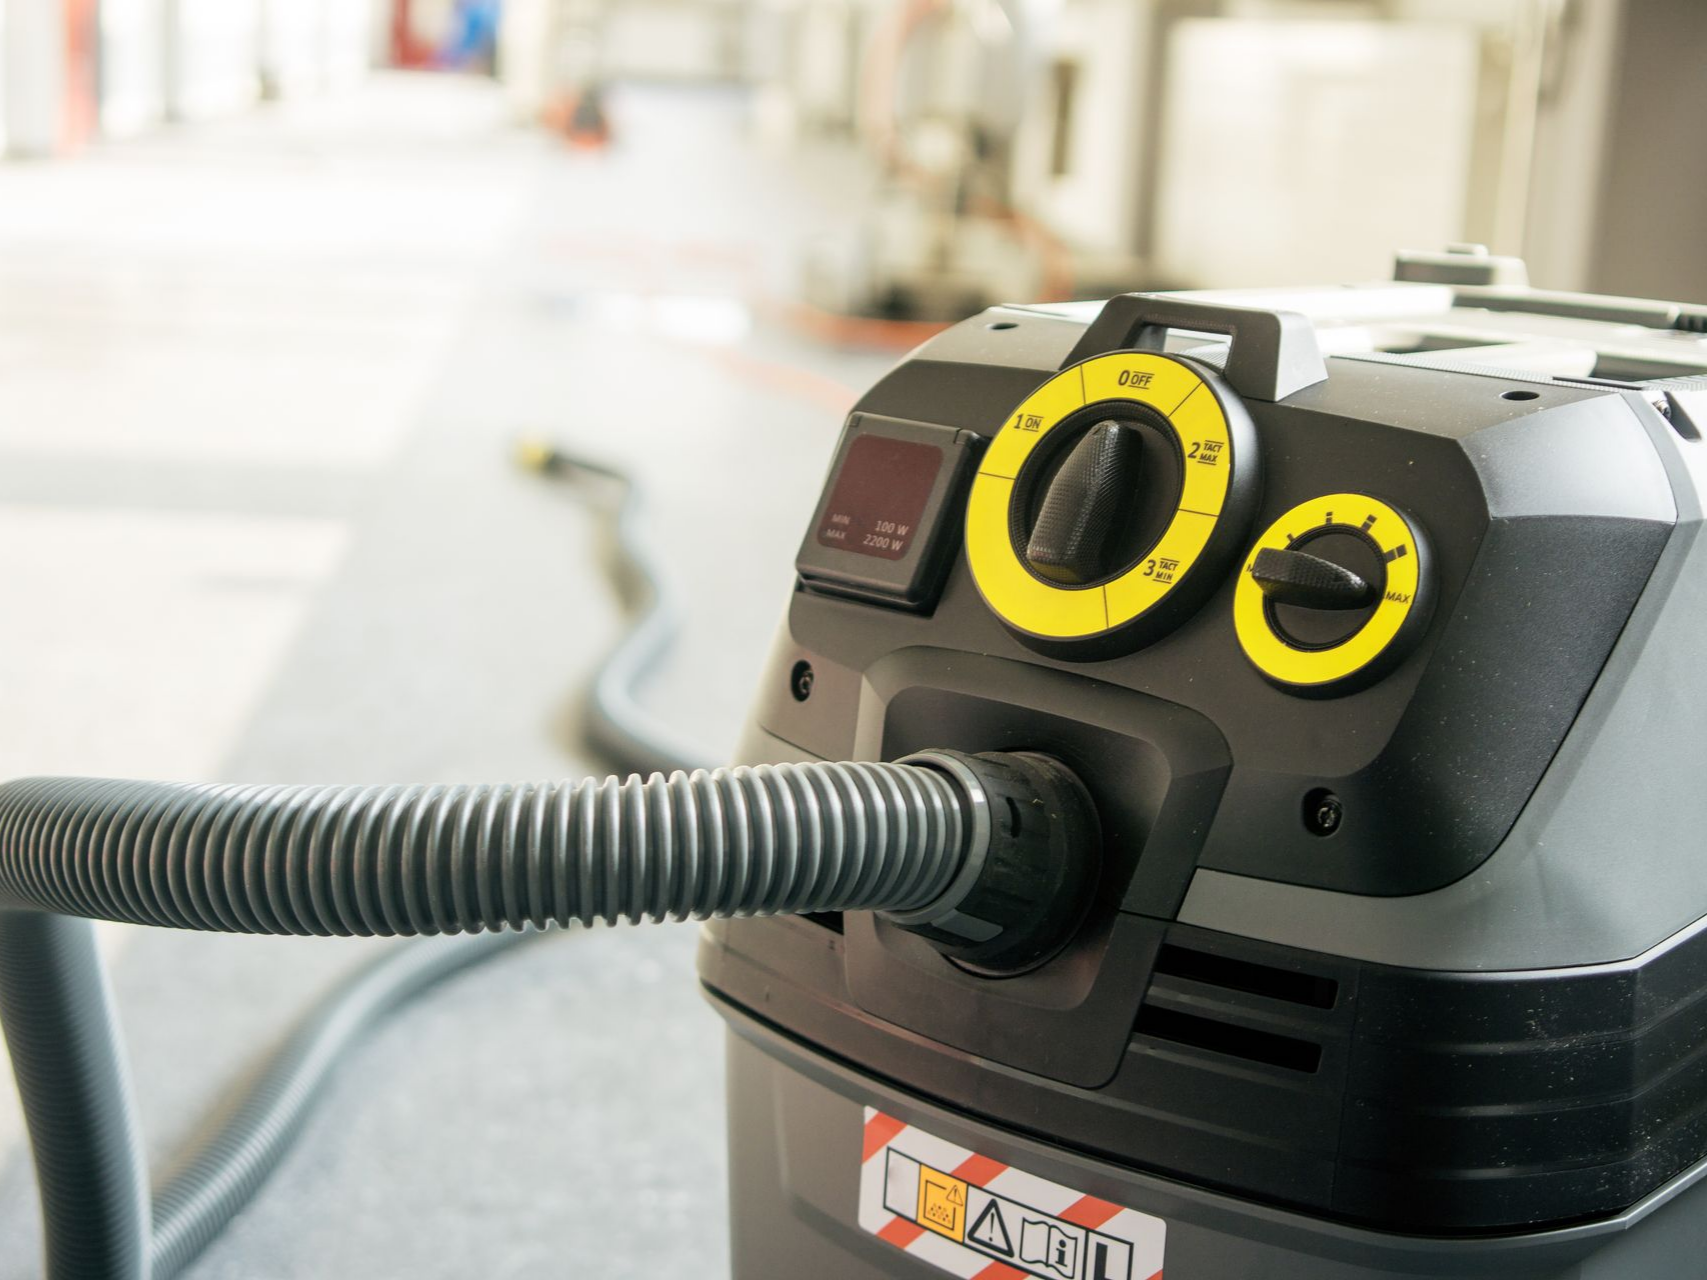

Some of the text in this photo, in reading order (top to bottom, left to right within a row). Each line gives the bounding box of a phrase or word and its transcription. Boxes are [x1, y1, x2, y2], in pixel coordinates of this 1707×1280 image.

[1118, 370, 1153, 386] 0 OFF
[1013, 413, 1042, 429] 1 ON
[1187, 442, 1223, 459] 2 TACT
[1199, 453, 1218, 462] MAX
[831, 513, 909, 535] MIN 100 W
[826, 528, 903, 551] MAX 2200 W
[1143, 559, 1178, 576] 3 TACT
[1155, 571, 1173, 580] MIN
[1386, 591, 1411, 604] MAX
